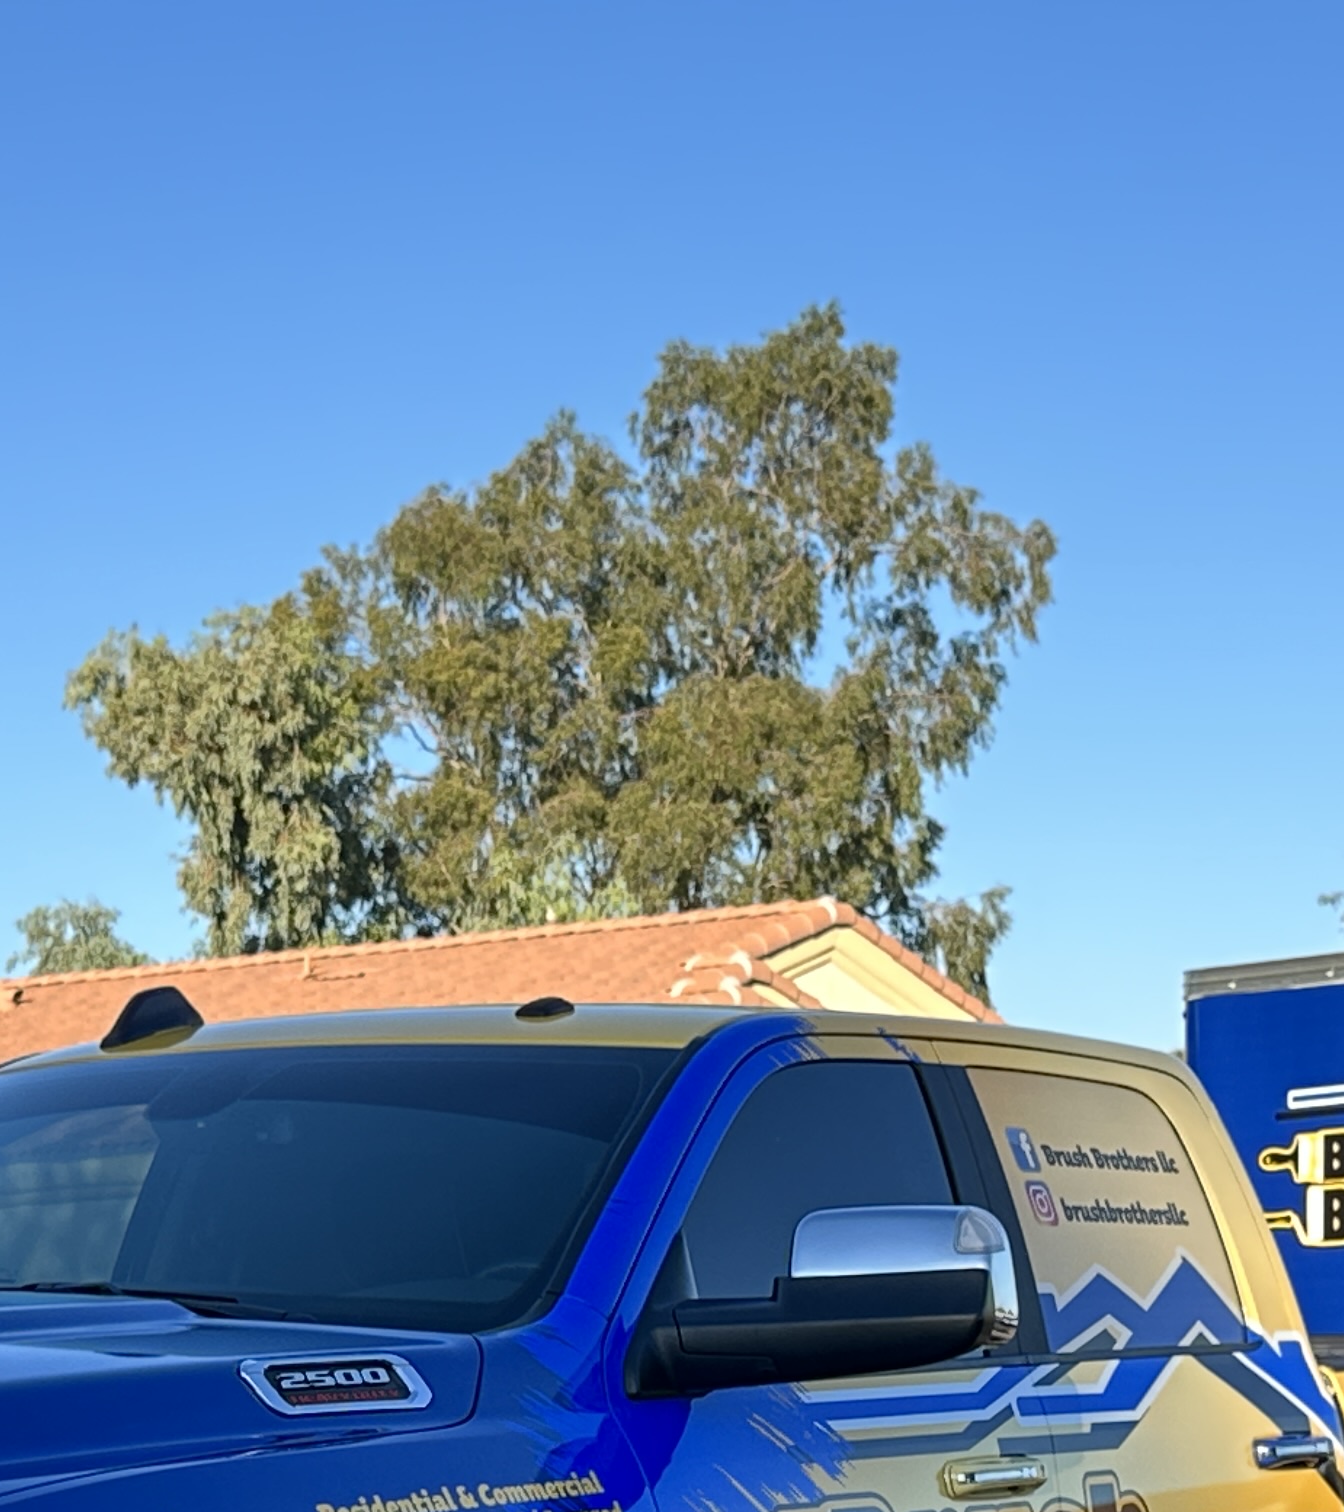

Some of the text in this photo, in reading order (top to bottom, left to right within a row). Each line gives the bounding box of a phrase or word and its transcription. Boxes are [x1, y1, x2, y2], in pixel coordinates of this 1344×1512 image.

[1041, 1145, 1179, 1174] Brush Brothers llc
[1060, 1197, 1189, 1226] brushbrothersllc
[275, 1367, 390, 1389] 2500
[458, 1484, 479, 1509] &
[478, 1469, 605, 1505] Commercial
